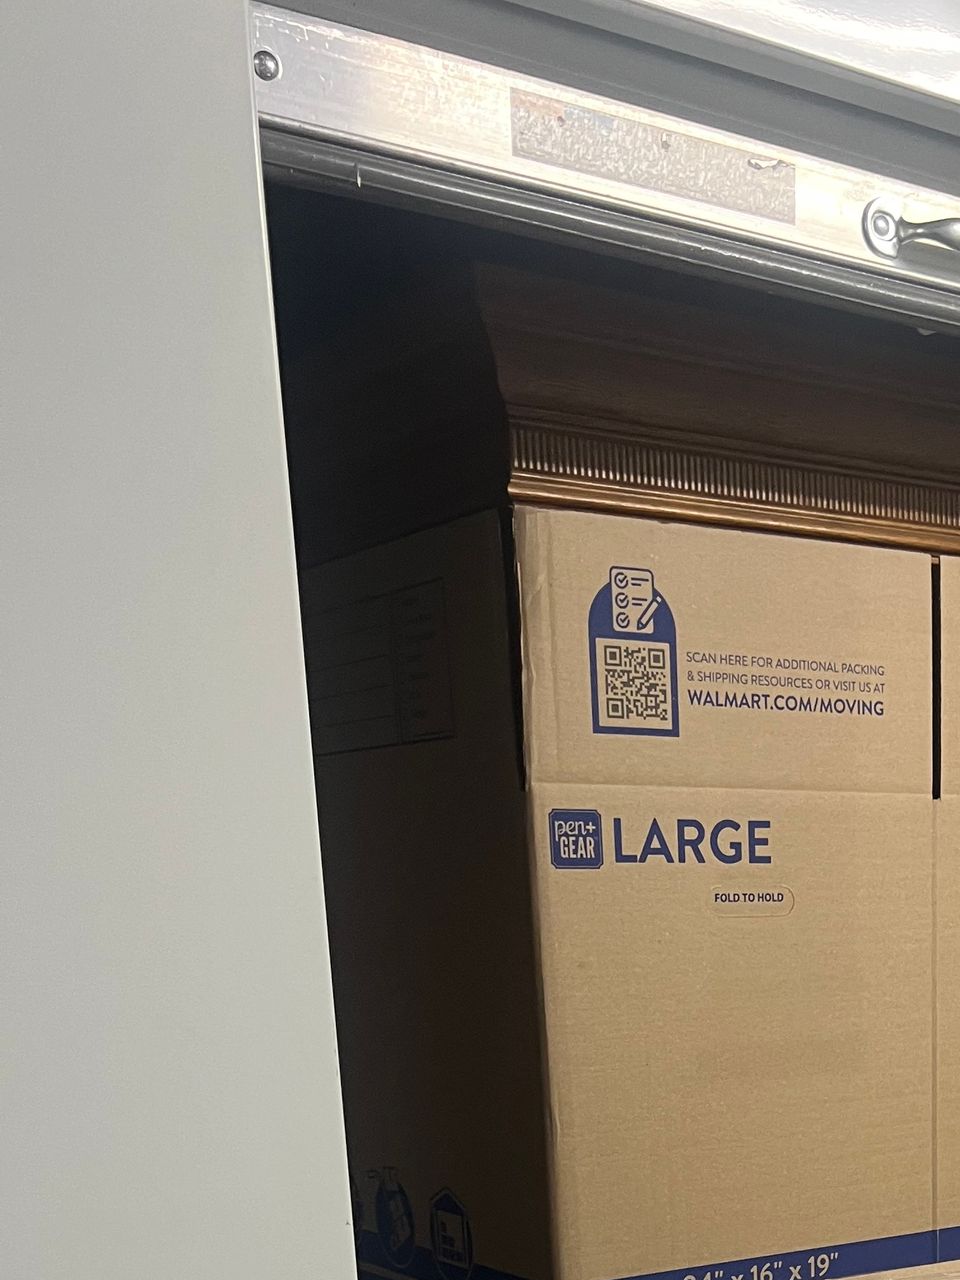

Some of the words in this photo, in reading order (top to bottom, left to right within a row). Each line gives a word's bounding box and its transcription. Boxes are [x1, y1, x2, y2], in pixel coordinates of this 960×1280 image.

[686, 651, 717, 666] SCAN
[719, 653, 748, 667] HERE
[751, 655, 773, 669] FOR
[775, 656, 839, 674] ADDITIONAL
[841, 662, 885, 677] PACKING
[687, 671, 695, 682] &
[697, 671, 748, 686] SHIPPING
[750, 674, 813, 690] RESOURCES
[815, 678, 831, 691] OR
[832, 679, 857, 693] VISIT
[858, 681, 872, 693] US
[873, 681, 886, 694] AT
[687, 689, 885, 716] WALMART.COM/MOVING
[559, 836, 596, 860] GEAR
[614, 817, 772, 864] LARGE
[714, 892, 740, 904] FOLD
[742, 892, 755, 904] TO
[757, 892, 784, 904] HOLD
[789, 1265, 802, 1280] x
[807, 1252, 839, 1278] 19"
